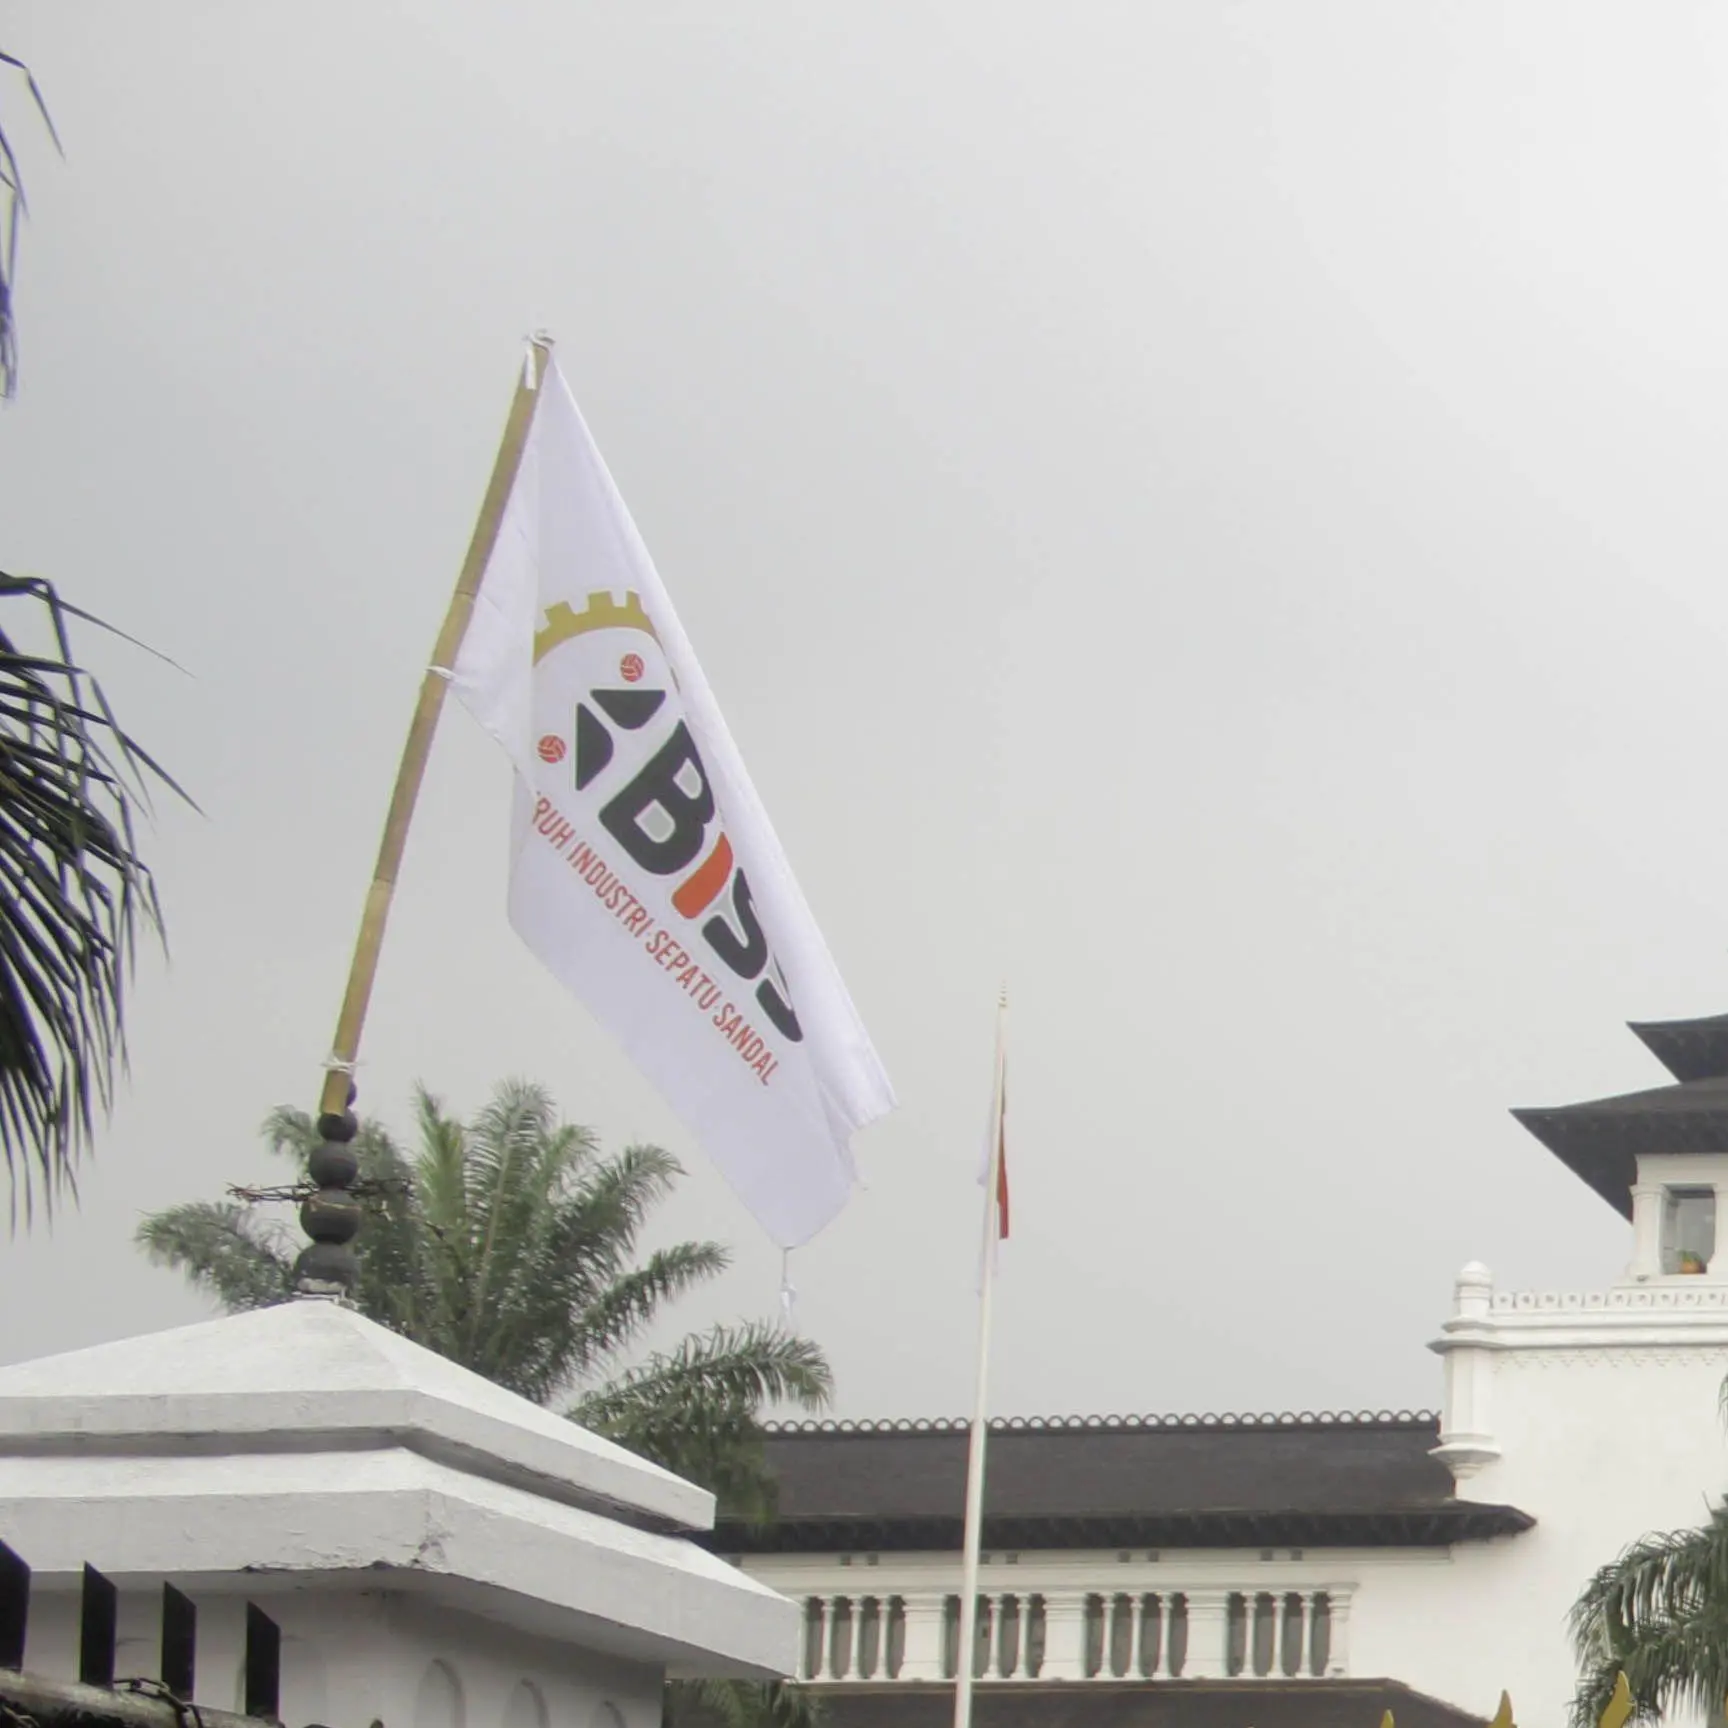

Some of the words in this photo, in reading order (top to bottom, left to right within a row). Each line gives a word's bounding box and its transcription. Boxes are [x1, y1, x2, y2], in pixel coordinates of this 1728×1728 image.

[566, 828, 653, 939] INDUSTRI
[645, 928, 718, 1013] SEPATU
[710, 1000, 780, 1087] SANDAL
